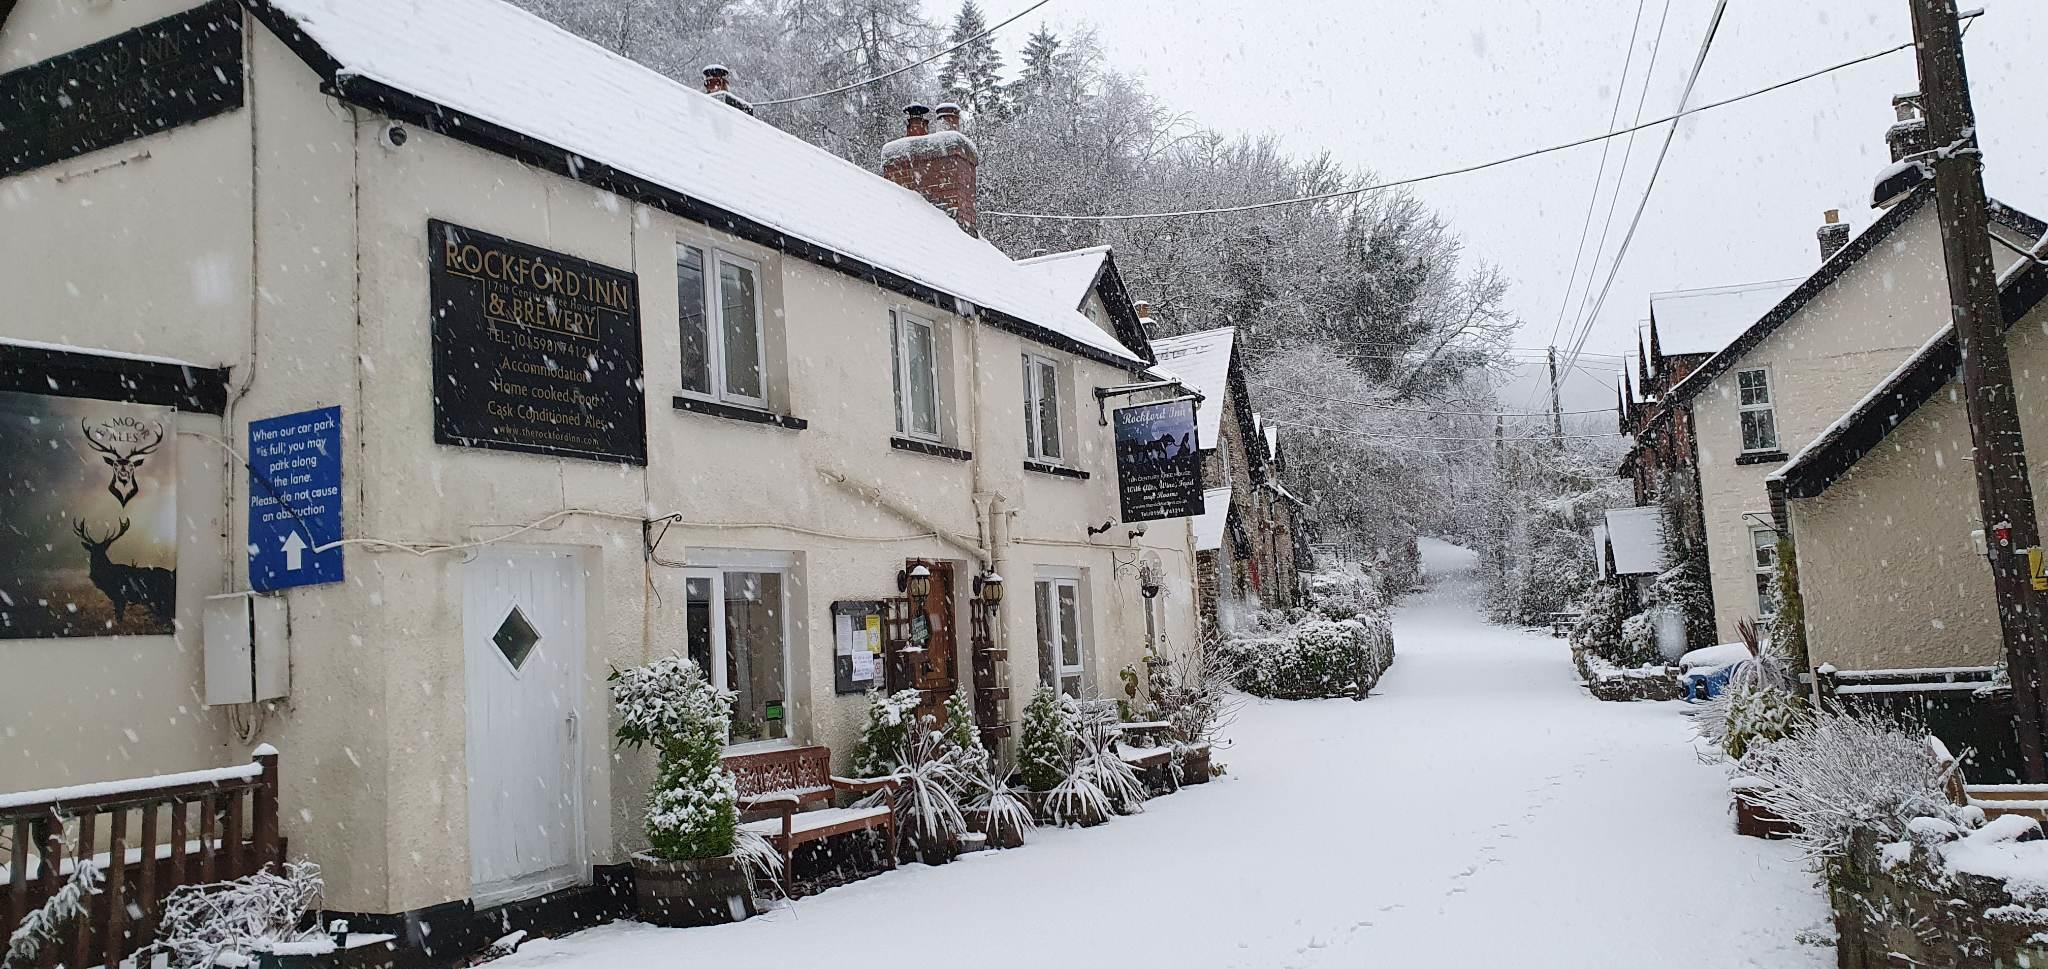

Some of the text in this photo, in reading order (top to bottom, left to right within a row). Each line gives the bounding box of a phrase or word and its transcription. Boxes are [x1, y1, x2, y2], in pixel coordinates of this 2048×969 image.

[445, 240, 628, 310] ROCKFORD INN
[487, 280, 509, 295] 17th
[570, 296, 596, 314] House
[488, 292, 595, 336] & BREWERY
[487, 328, 510, 345] TEL:
[502, 356, 591, 383] Accommodation
[494, 378, 599, 408] Home cooked Food
[487, 401, 513, 418] Cask
[517, 404, 580, 427] Conditioned
[1122, 406, 1186, 425] Rockford Inn
[96, 416, 150, 440] EXMOOR
[109, 431, 138, 443] ALES
[253, 417, 335, 443] When our car park
[260, 445, 268, 456] is
[288, 442, 305, 455] you
[307, 438, 327, 450] may
[270, 455, 317, 475] park along
[274, 475, 288, 488] the
[280, 490, 292, 504] do
[294, 488, 309, 501] not
[311, 486, 338, 499] cause
[262, 511, 274, 522] an
